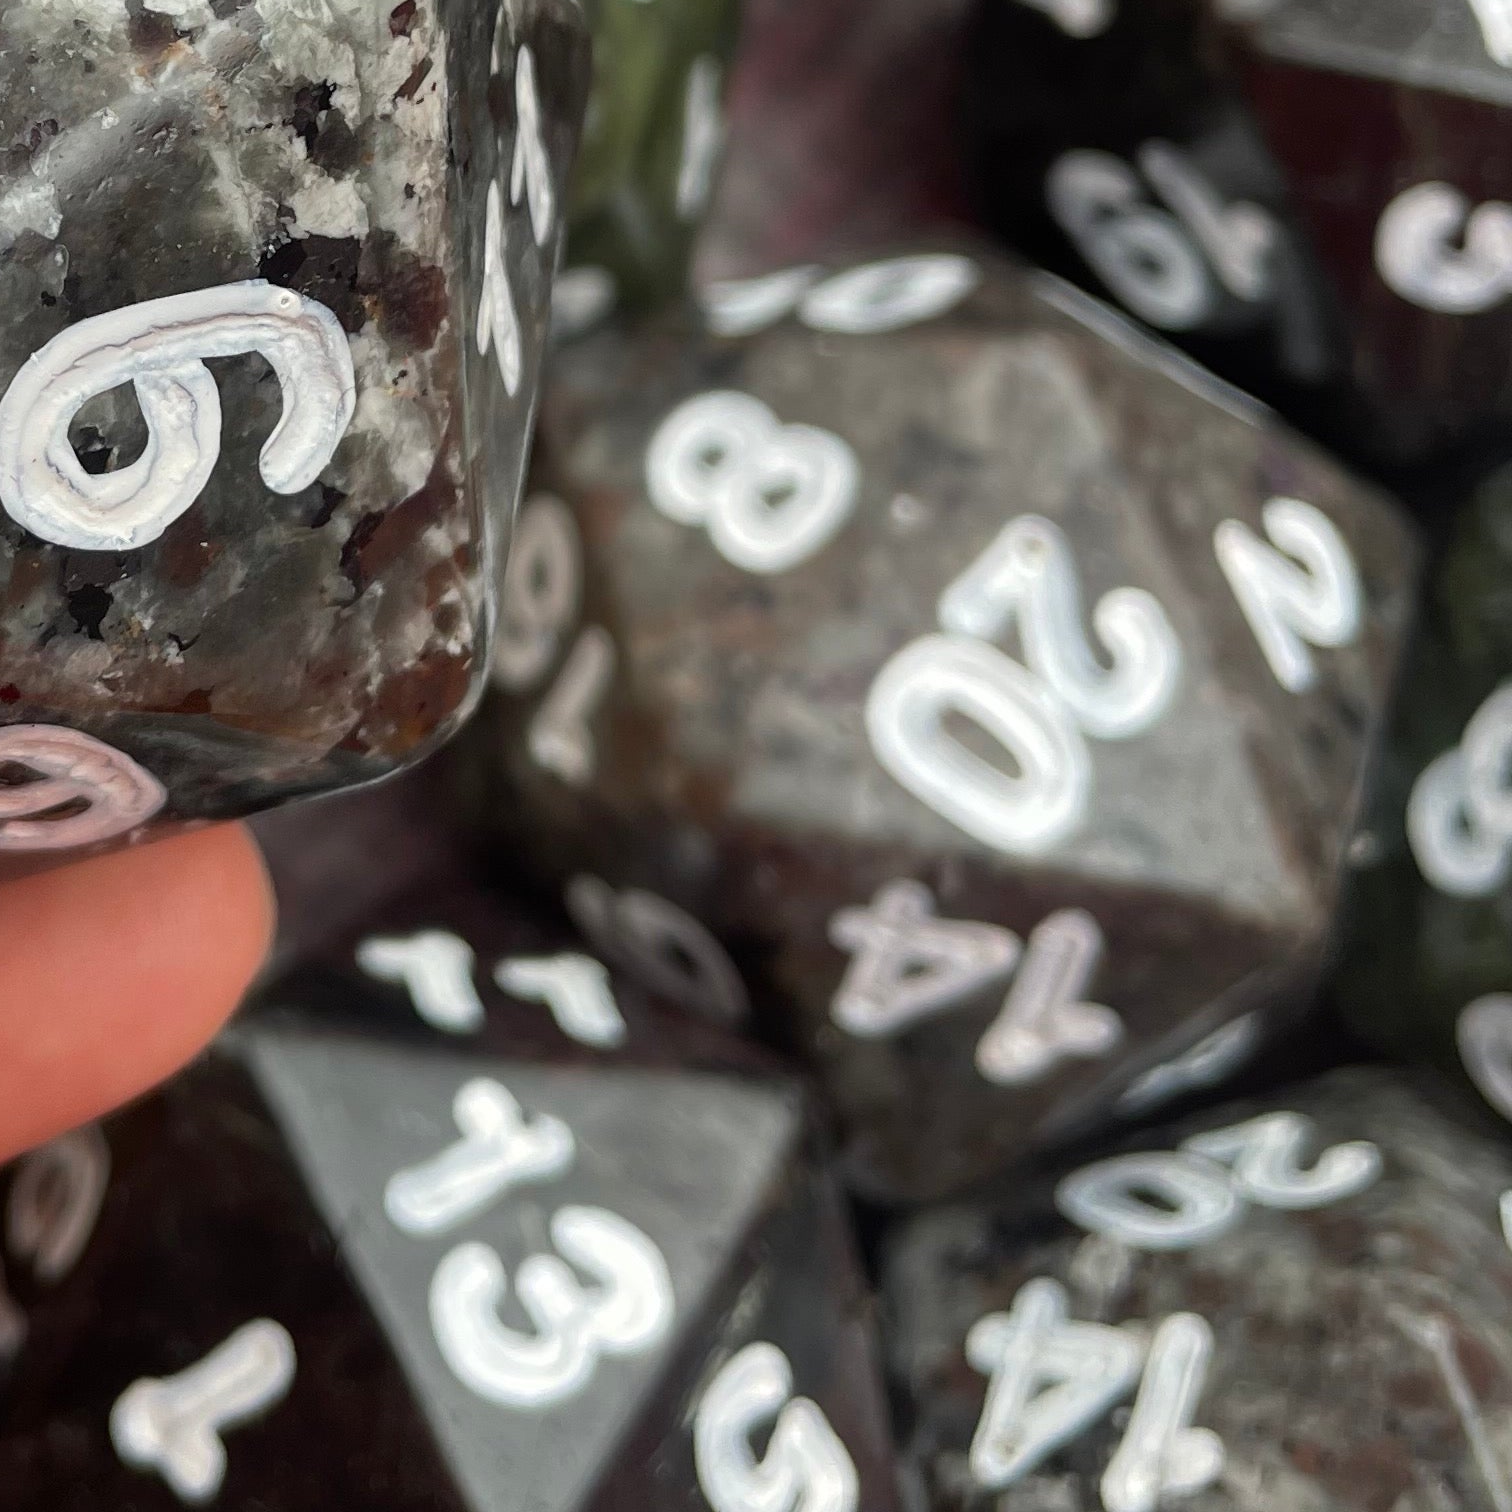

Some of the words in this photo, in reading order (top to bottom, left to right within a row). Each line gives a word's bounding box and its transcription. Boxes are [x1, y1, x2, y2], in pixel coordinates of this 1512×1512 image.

[645, 390, 862, 575] 8
[865, 513, 1183, 854] 20
[1212, 496, 1363, 694] 2
[355, 928, 628, 1048] 11
[828, 878, 1125, 1086] 14
[383, 1075, 676, 1408] 13
[1054, 1111, 1384, 1250] 20
[108, 1317, 298, 1502] 1
[966, 1276, 1226, 1512] 14
